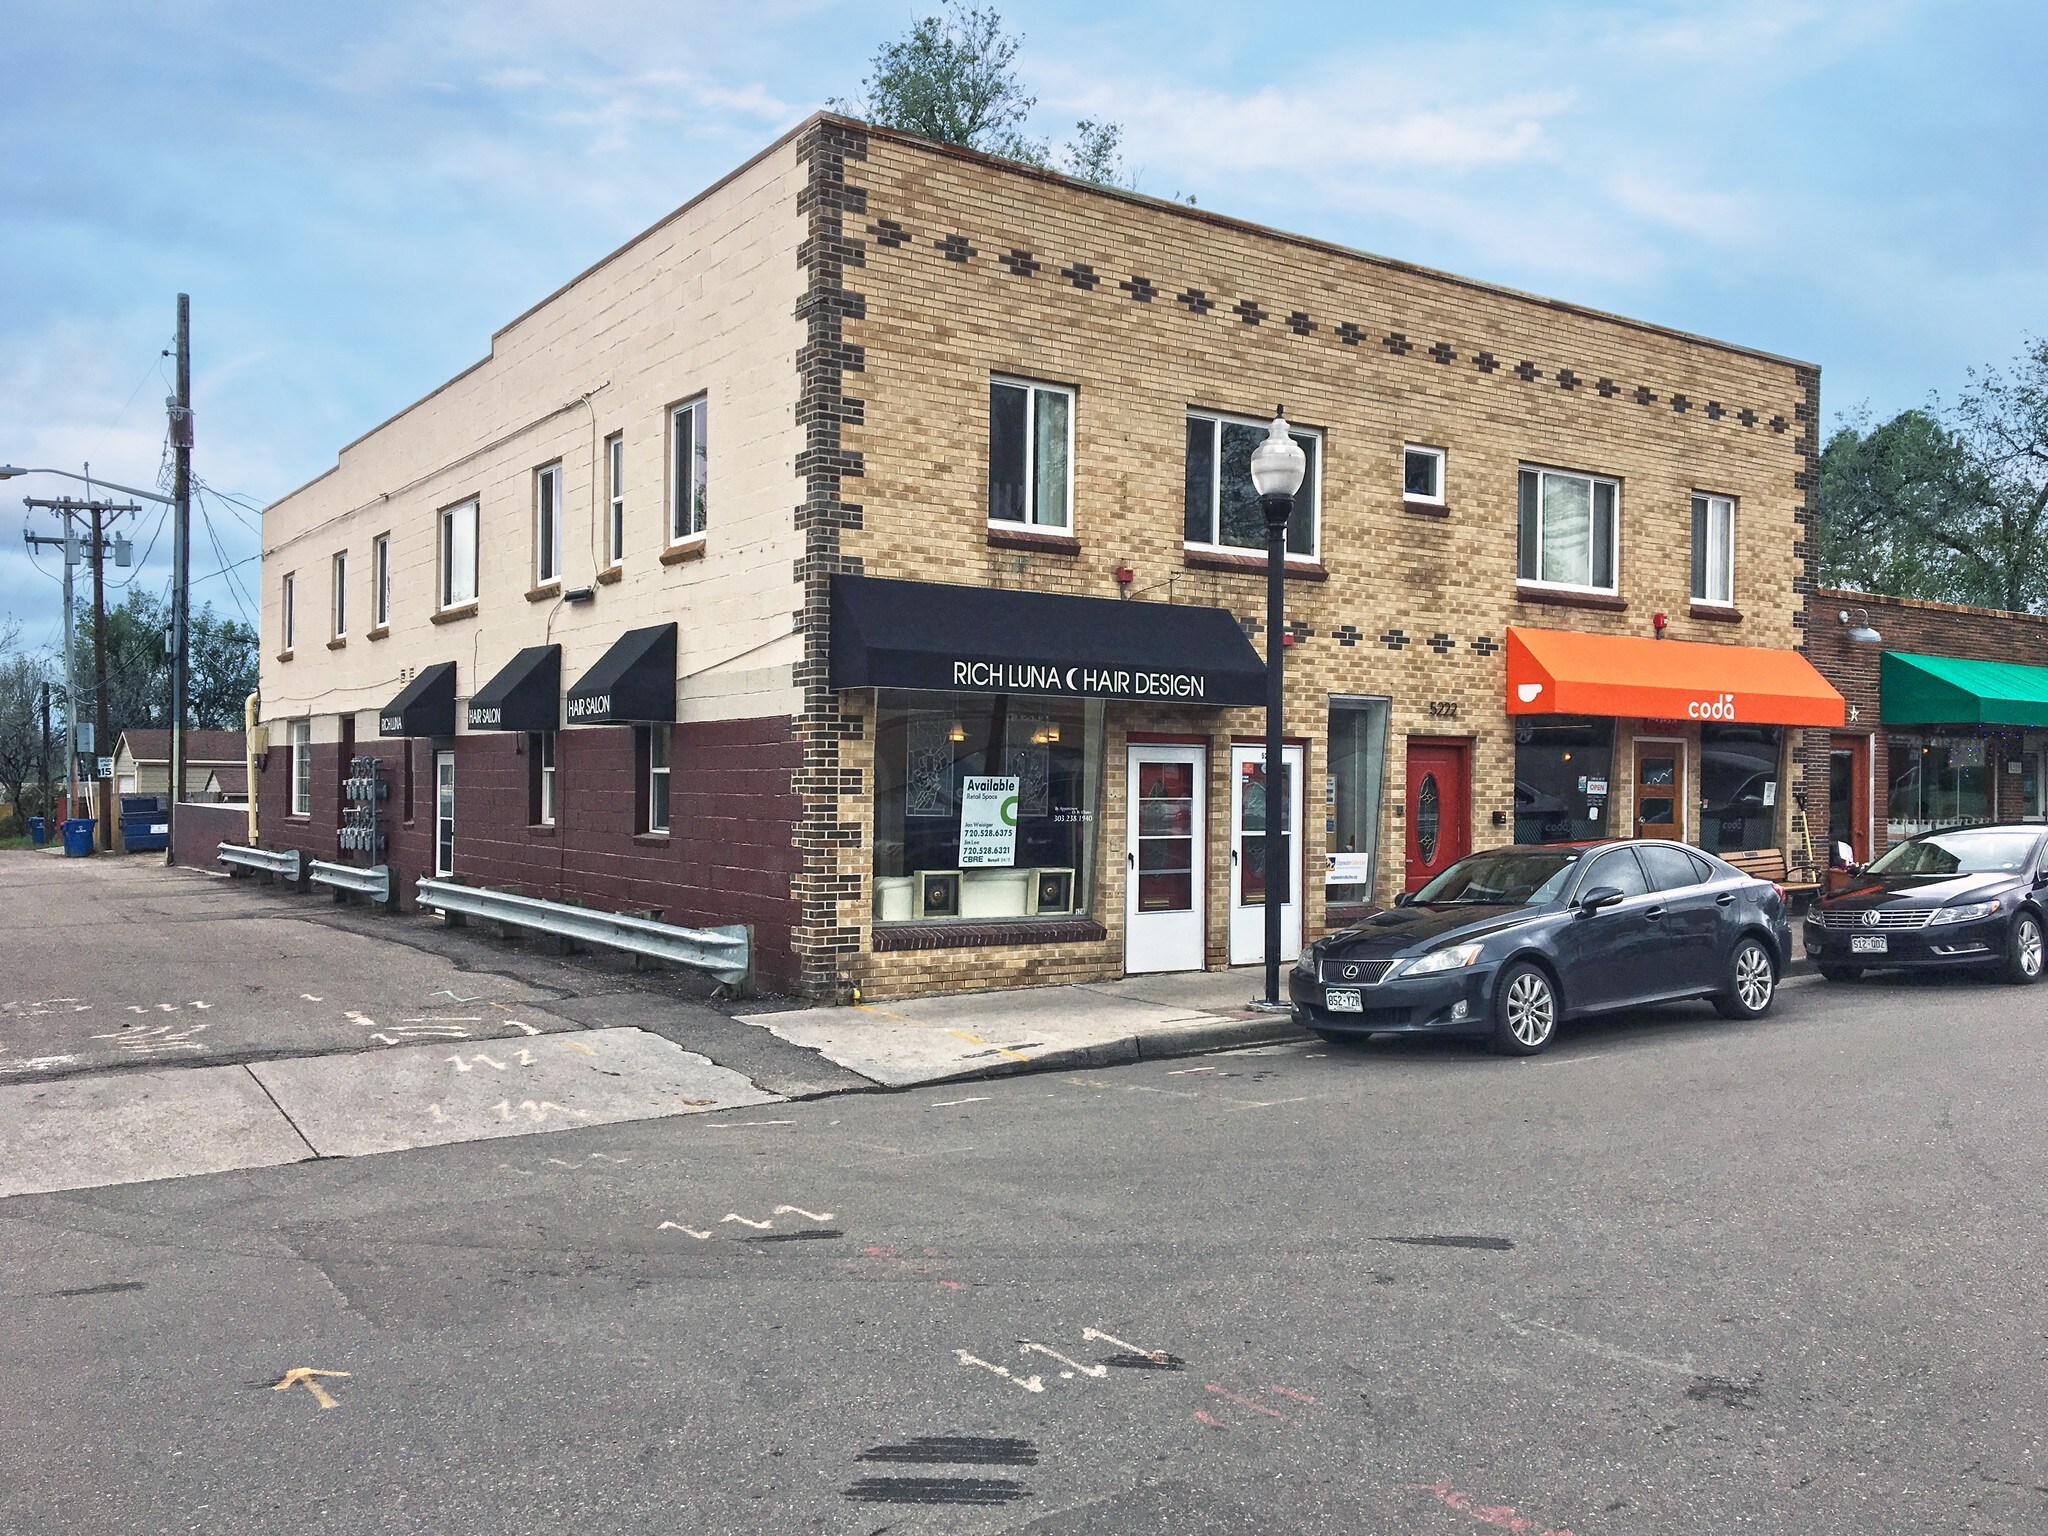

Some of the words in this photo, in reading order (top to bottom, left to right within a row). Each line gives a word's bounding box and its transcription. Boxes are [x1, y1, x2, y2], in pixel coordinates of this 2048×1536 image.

[953, 661, 1004, 687] RICH
[1008, 664, 1062, 690] LUNA
[1083, 669, 1130, 693] HAIR
[1135, 672, 1205, 698] DESIGN
[568, 698, 585, 717] HAIR
[585, 695, 611, 715] SALON
[1429, 701, 1458, 718] 5222
[468, 708, 482, 724] HAIR
[482, 707, 501, 723] SALON
[101, 767, 112, 776] 15
[967, 779, 1015, 791] Available
[982, 793, 998, 801] Space
[964, 829, 1013, 837] 720.528.6375
[963, 846, 1010, 855] 720.528.6321
[962, 855, 984, 863] CBRE
